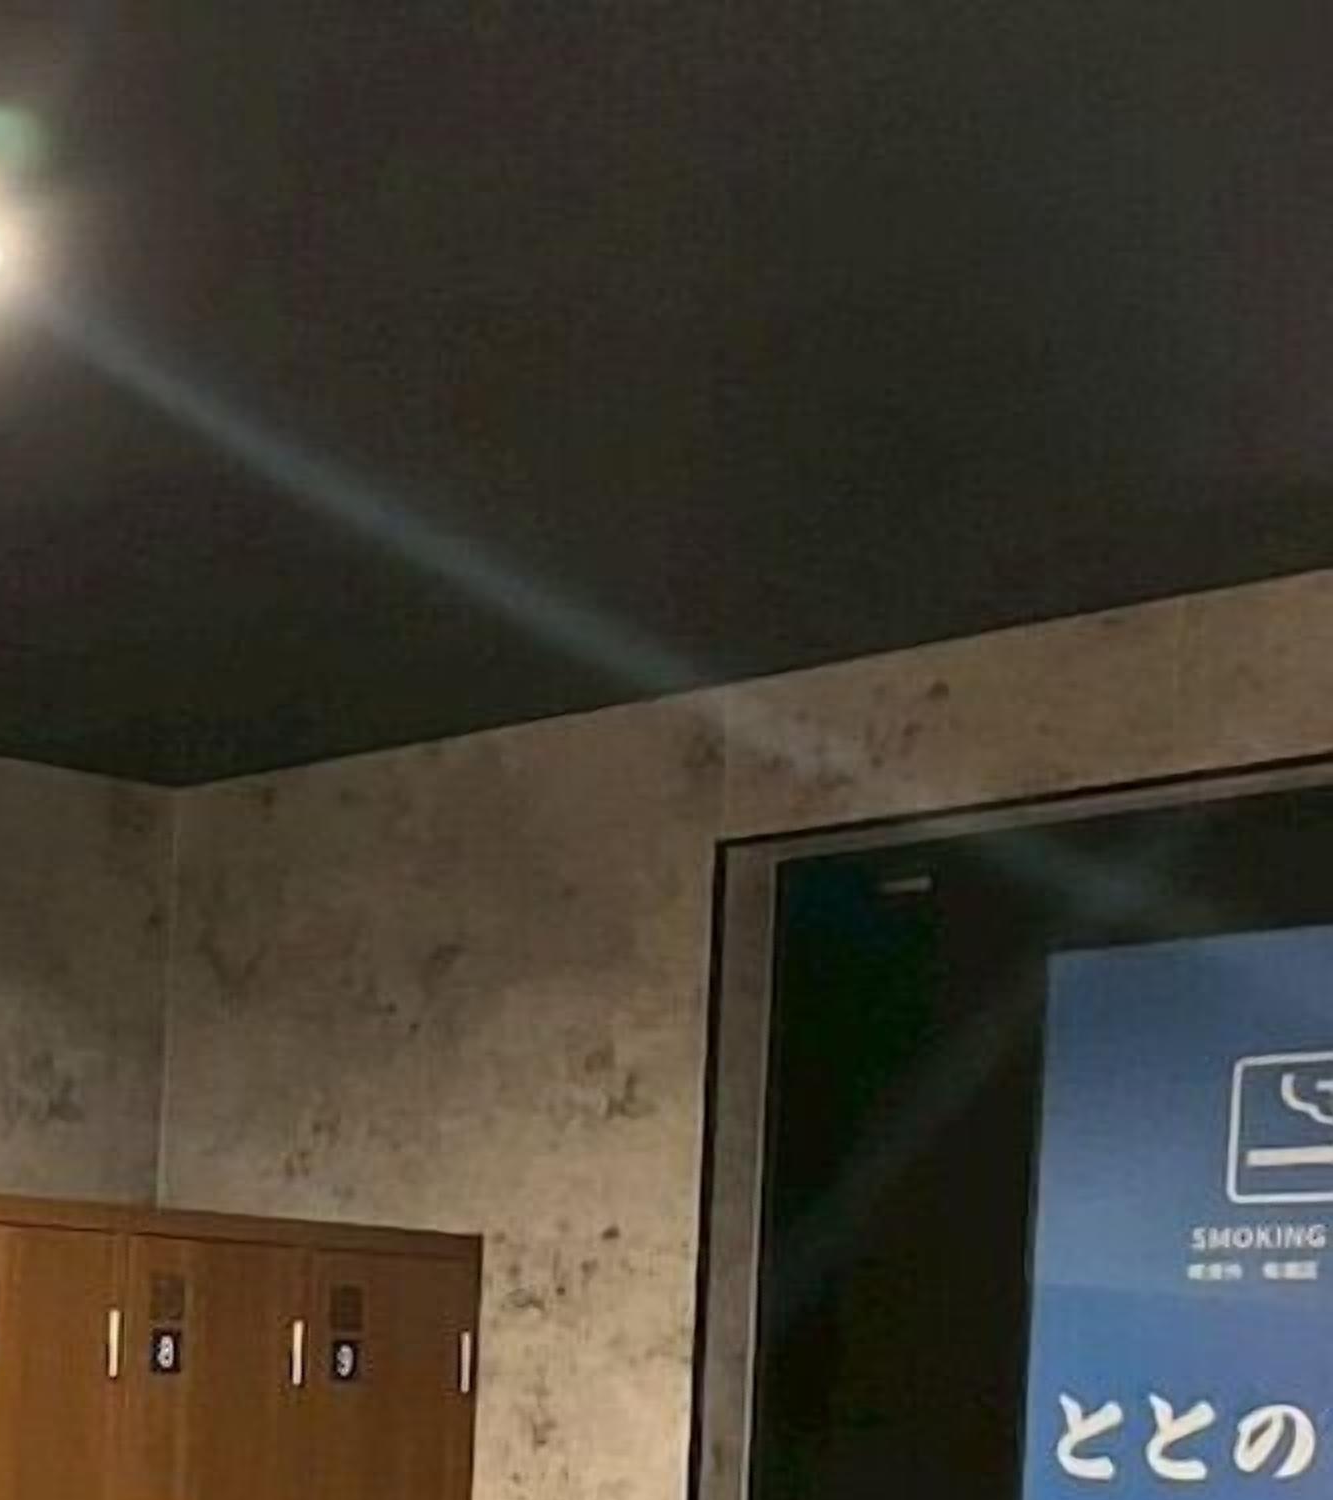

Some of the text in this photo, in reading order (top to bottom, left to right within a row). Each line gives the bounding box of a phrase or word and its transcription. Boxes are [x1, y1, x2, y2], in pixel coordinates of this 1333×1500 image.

[1191, 1224, 1326, 1249] SMOKING
[159, 1335, 174, 1368] 8
[337, 1344, 352, 1376] 9
